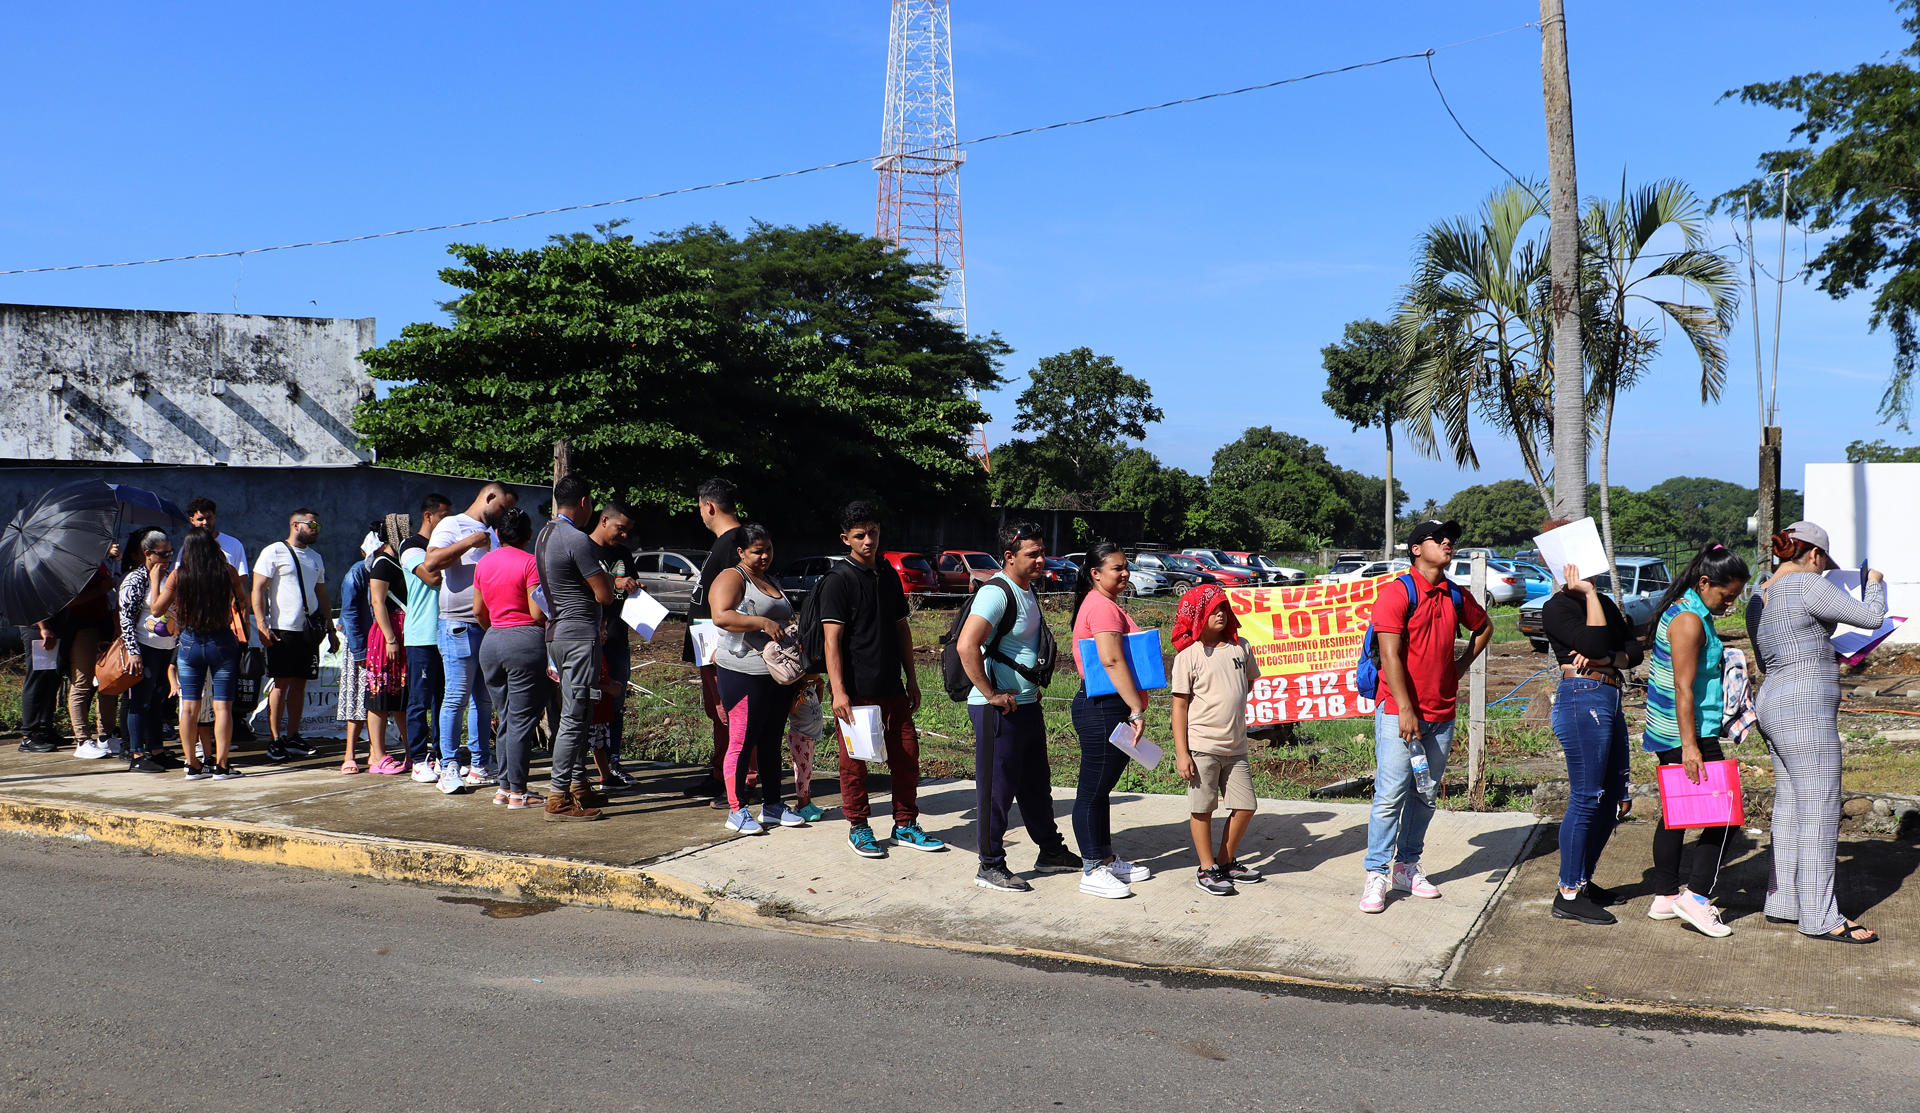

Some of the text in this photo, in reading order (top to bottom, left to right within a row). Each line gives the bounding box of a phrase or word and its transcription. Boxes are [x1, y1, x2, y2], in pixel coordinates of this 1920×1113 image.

[1231, 589, 1271, 615] SE
[1272, 603, 1373, 640] LOTES
[1251, 635, 1364, 655] ACCIONAMIENTO RESIDENCI
[1267, 653, 1304, 666] COSTADO
[1307, 652, 1317, 662] DE
[1319, 650, 1328, 661] LA
[307, 691, 339, 706] VIC
[1248, 678, 1288, 701] 62
[1294, 672, 1339, 696] 112
[1297, 695, 1346, 719] 218
